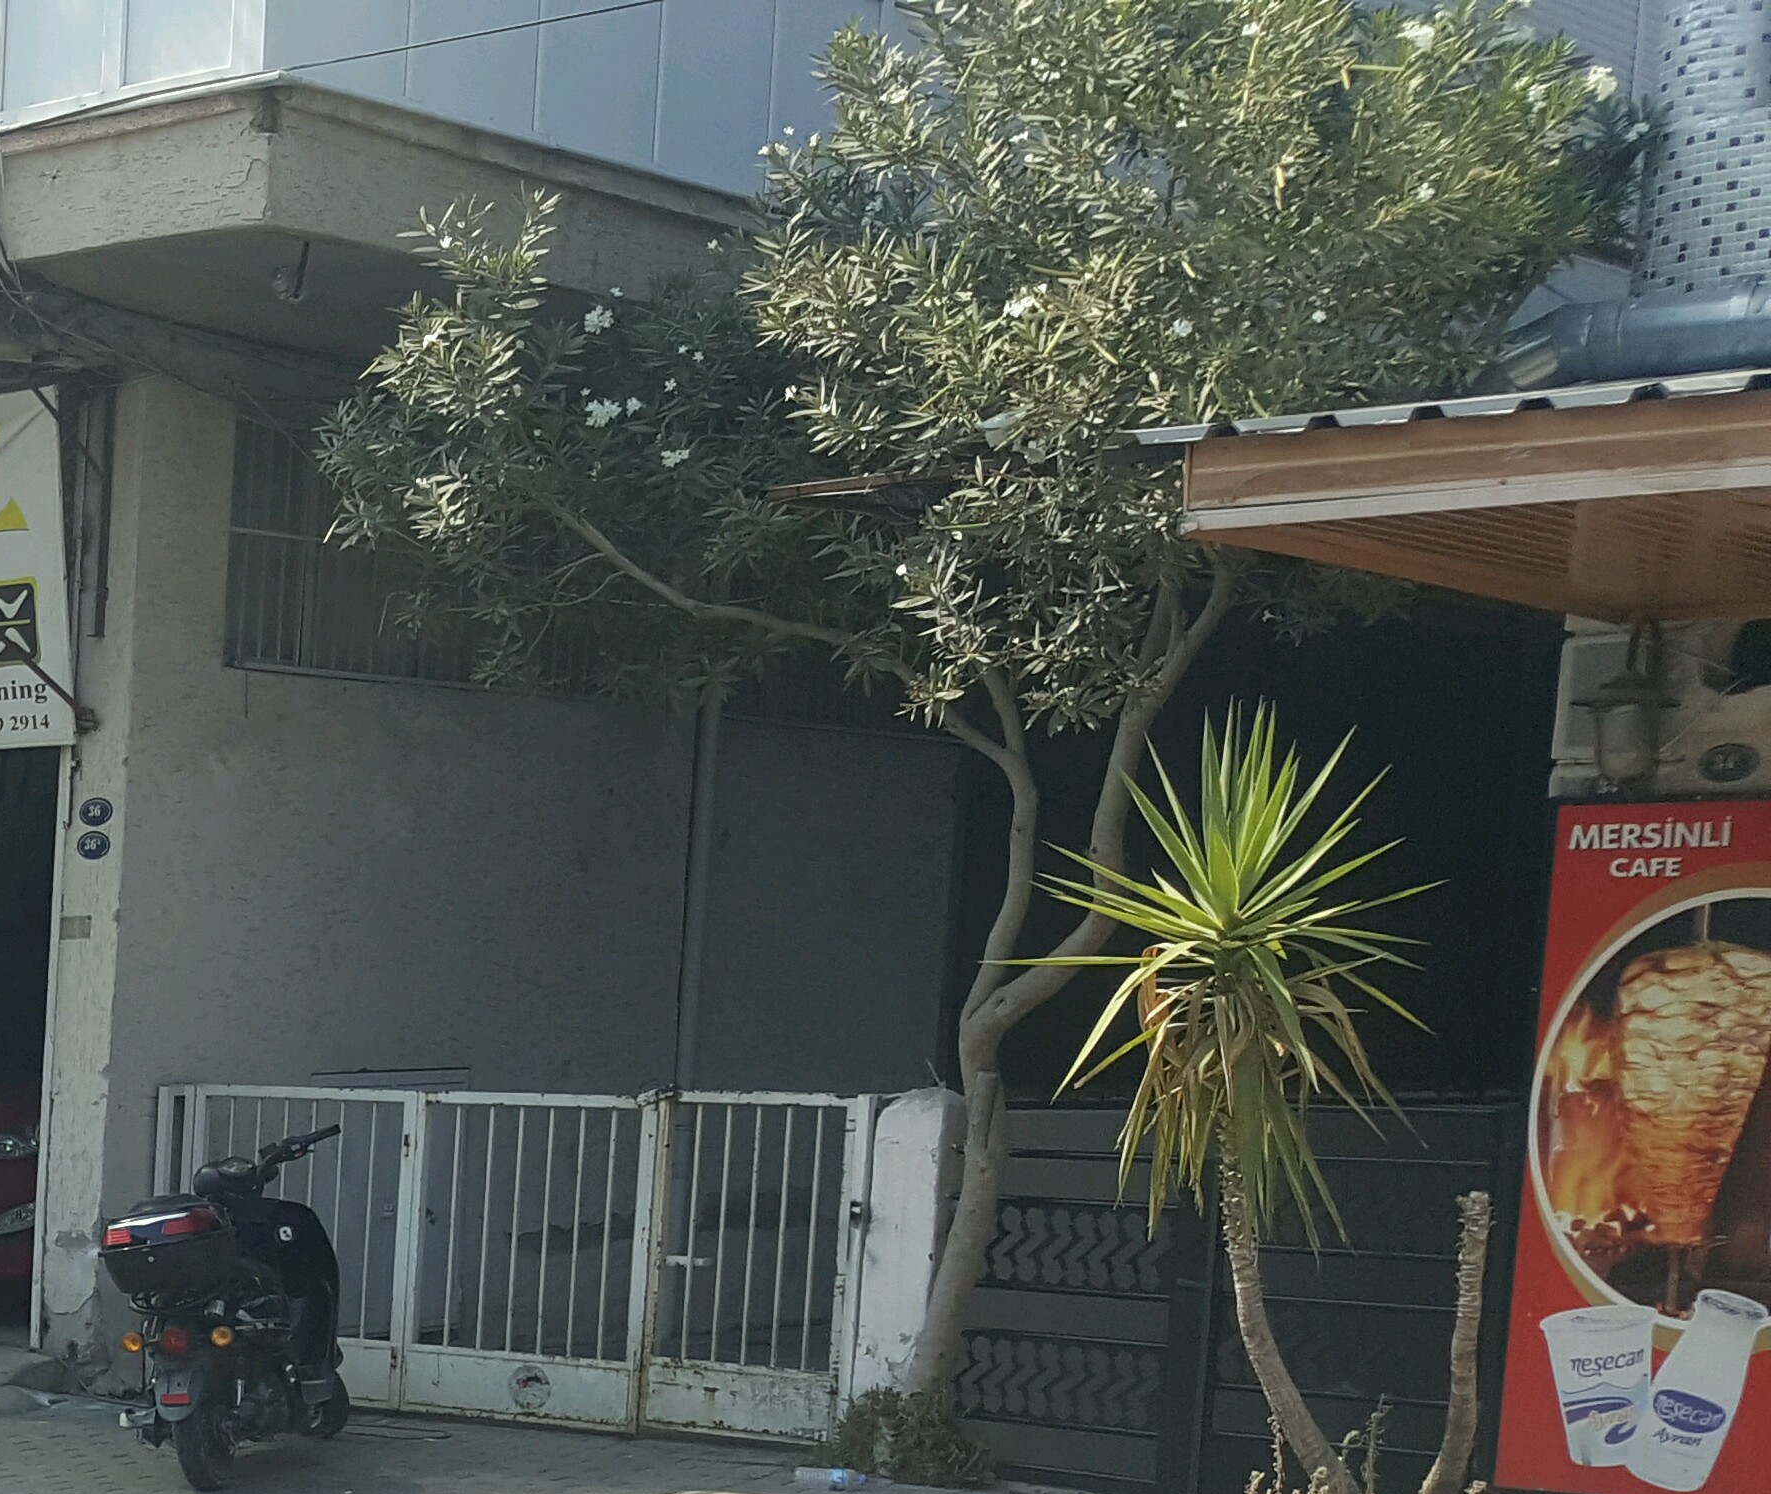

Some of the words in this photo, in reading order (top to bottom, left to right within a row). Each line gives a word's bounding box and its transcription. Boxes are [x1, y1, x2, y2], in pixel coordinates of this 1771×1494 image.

[9, 714, 51, 732] 2914
[87, 804, 102, 818] 36
[1568, 815, 1735, 850] MERSİNLİ
[1610, 857, 1684, 878] CAFE
